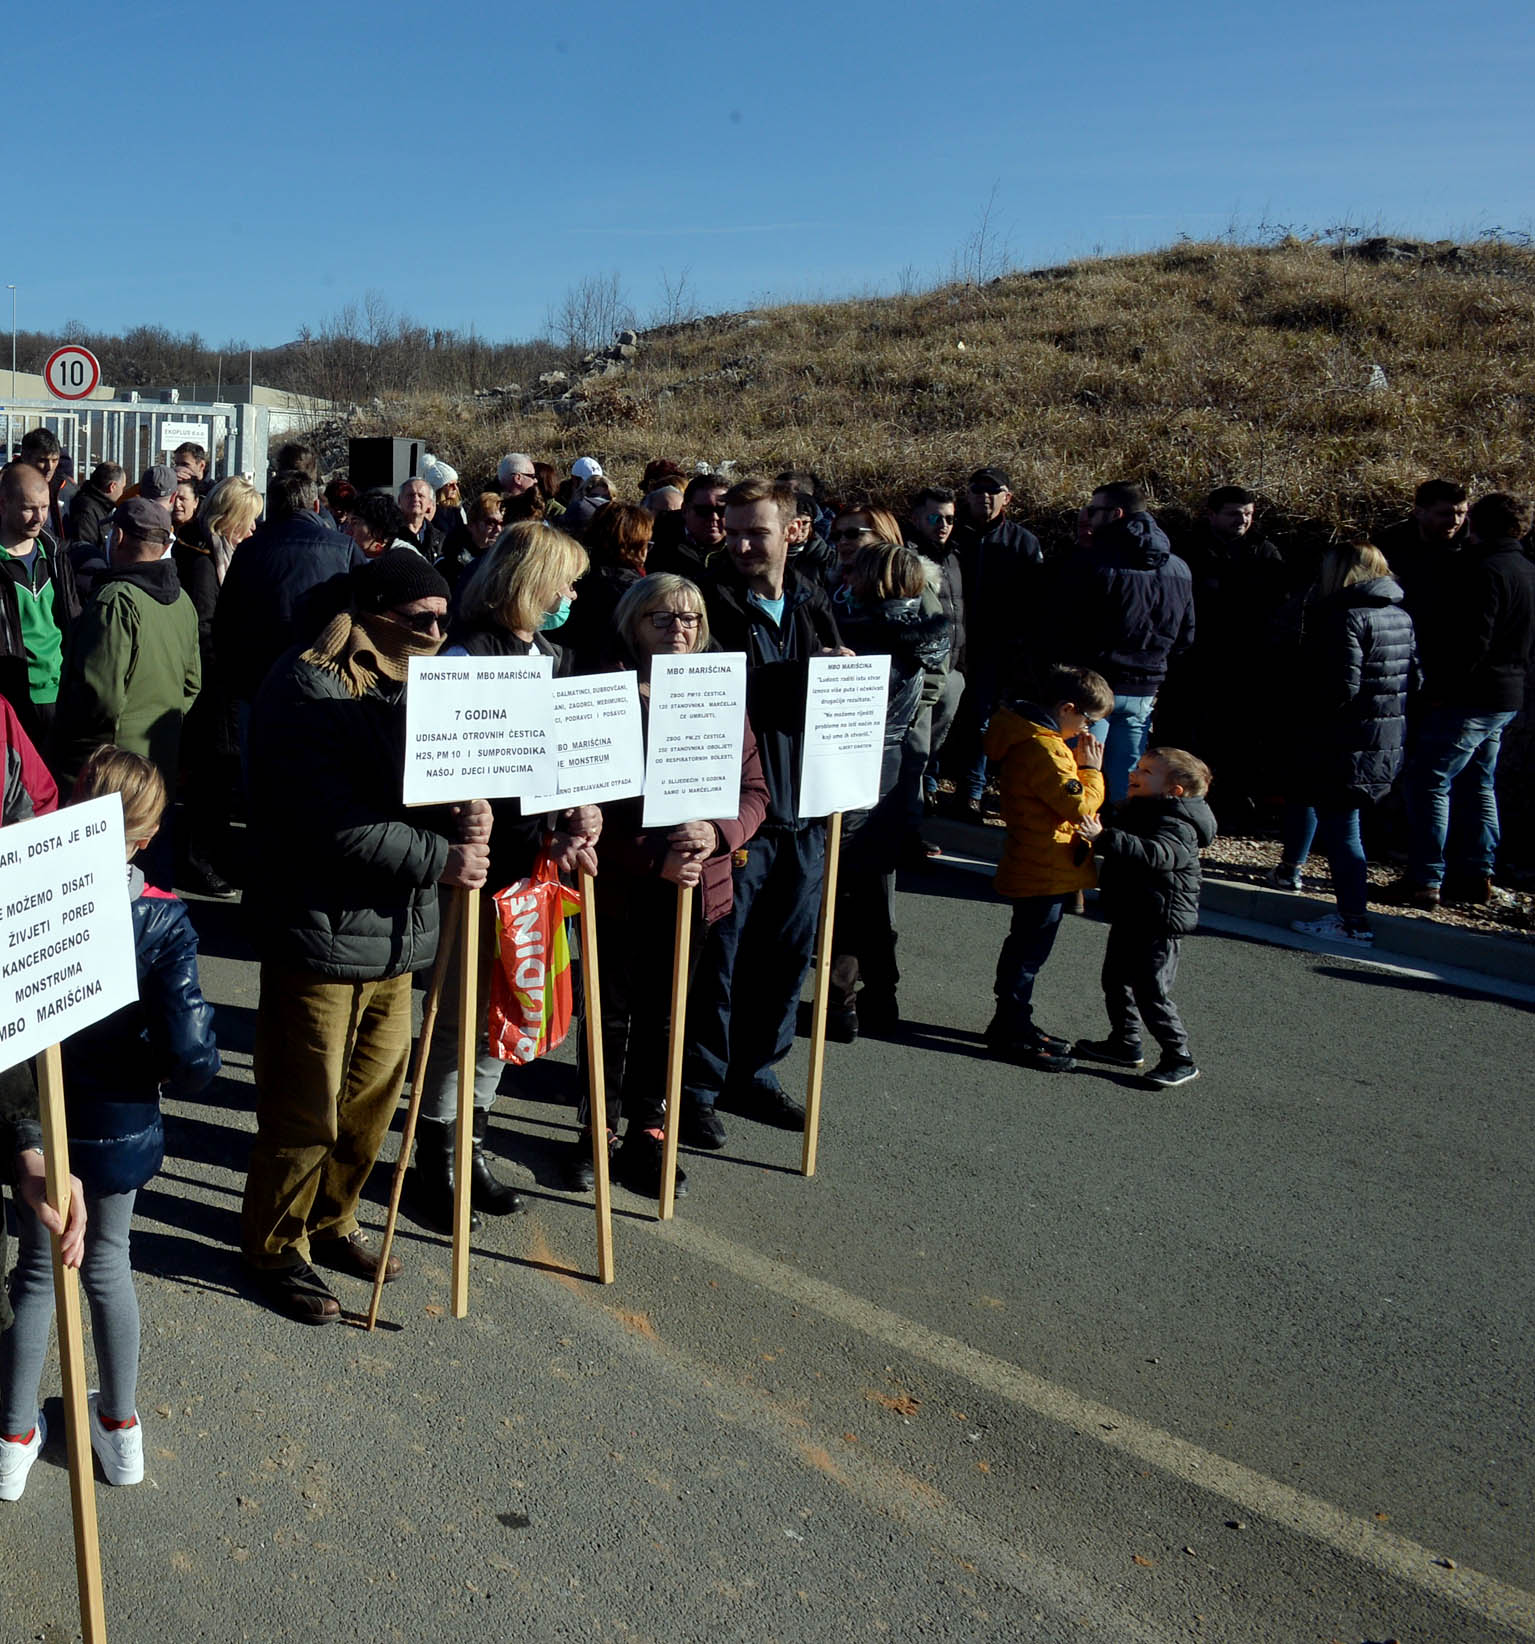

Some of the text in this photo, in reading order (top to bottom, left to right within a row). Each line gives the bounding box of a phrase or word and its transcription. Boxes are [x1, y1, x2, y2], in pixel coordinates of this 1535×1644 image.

[59, 360, 84, 387] 10
[419, 669, 541, 680] MONSTRUM MBO MARIŠĆINA
[666, 665, 731, 675] MBO MARIŠĆINA
[455, 709, 507, 720] 7 GODINA
[565, 713, 593, 723] PODRAVCI
[603, 709, 626, 718] POSAVCI
[416, 729, 546, 742] UDISANJA OTROVNIH ČESTICA
[557, 737, 612, 751] BO MARIŠĆINA
[416, 747, 546, 760] H2S, PM 10 I SUMPORVODIKA
[568, 753, 610, 766] MONSTRUM
[426, 764, 534, 777] NAŠOJ DJECI I UNUCIMA
[610, 778, 632, 787] OTPADA
[27, 835, 63, 858] DOSTA
[68, 831, 80, 844] JE
[84, 820, 107, 838] BILO
[6, 888, 54, 919] MOŽEMO
[61, 873, 94, 896] DISATI
[8, 919, 51, 948] ŽIVJETI
[61, 901, 95, 925] PORED
[1, 928, 91, 979] KANCEROGENOG
[15, 961, 83, 1003] MONSTRUMA
[36, 979, 103, 1023] MARIŠĆINA
